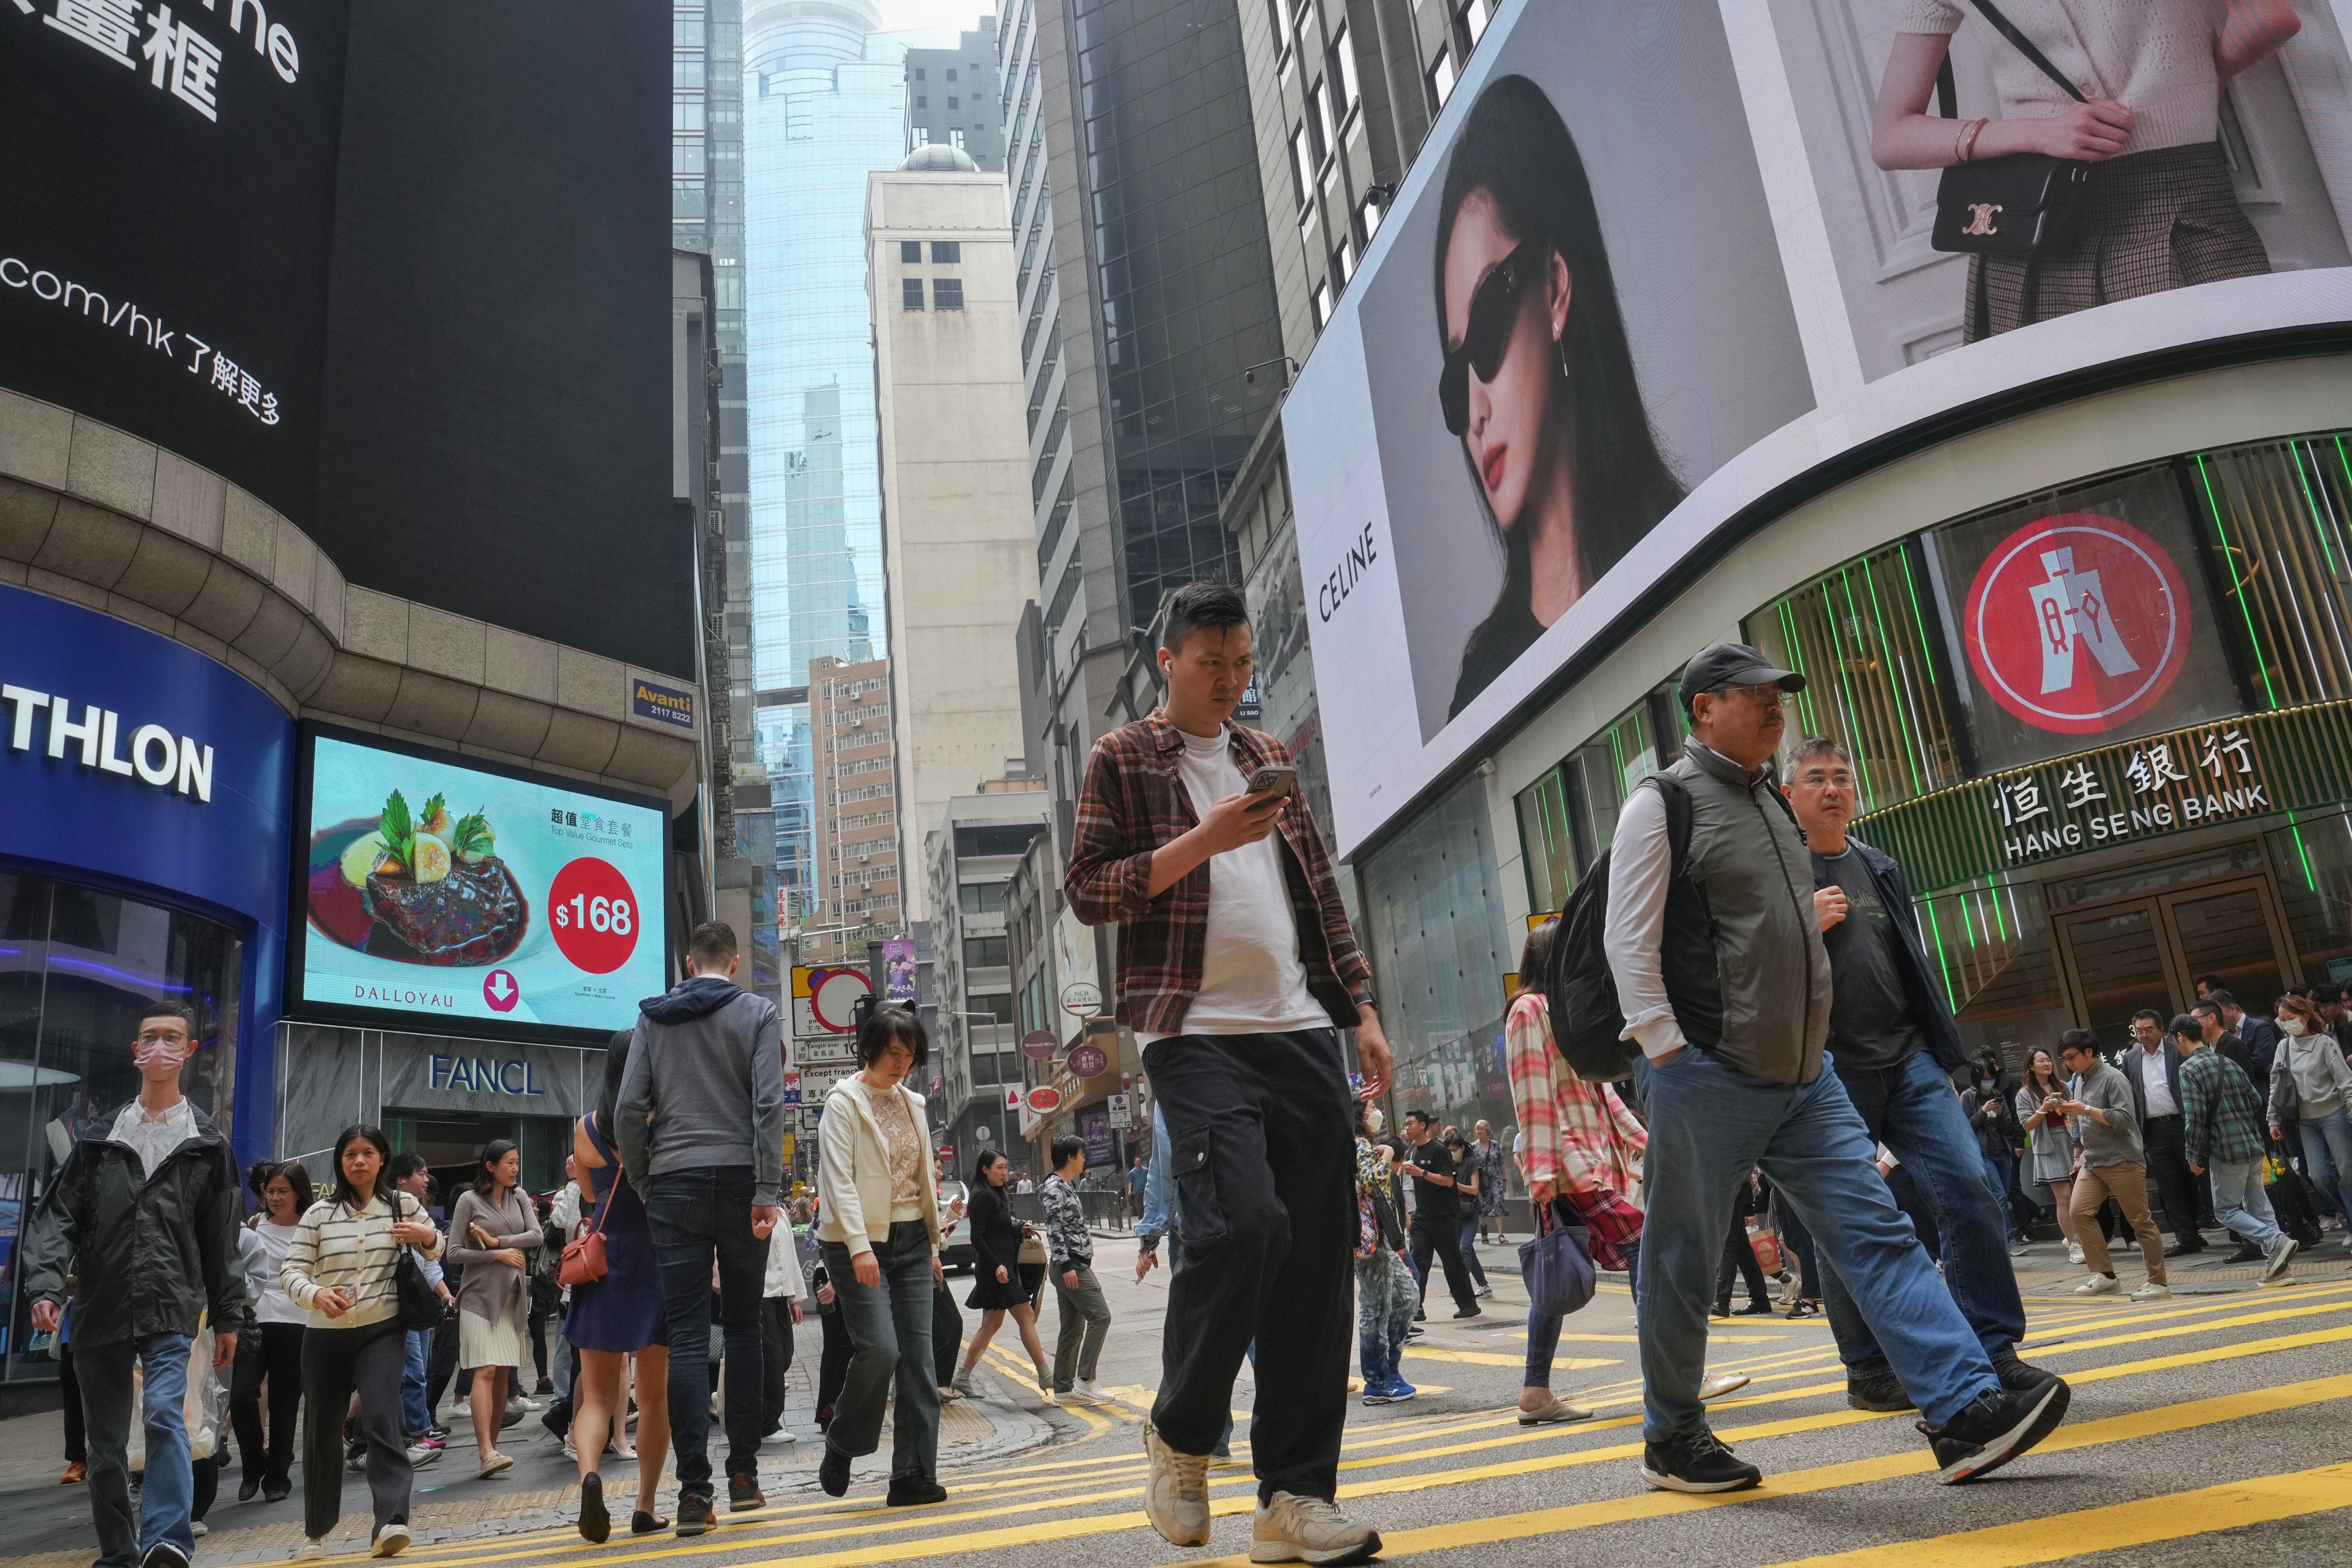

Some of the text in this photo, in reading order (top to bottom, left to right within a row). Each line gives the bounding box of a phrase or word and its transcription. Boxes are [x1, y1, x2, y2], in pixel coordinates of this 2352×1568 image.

[13, 0, 222, 123] 畫框
[185, 333, 280, 425] 了解更多
[1320, 521, 1377, 622] CELINE
[636, 686, 690, 712] Avanti
[651, 705, 690, 723] 2117 8222
[2, 683, 214, 802] THLON
[1993, 730, 2253, 827] 恒生銀行
[551, 808, 632, 838] 超值堂食套餐
[551, 825, 633, 849] Top Value Gourmet Sets
[2003, 785, 2268, 860] HANG SENG BANK
[556, 893, 631, 935] $168
[355, 985, 453, 1007] DALLOYAU
[430, 1054, 543, 1095] FANCL
[805, 1069, 832, 1077] Except
